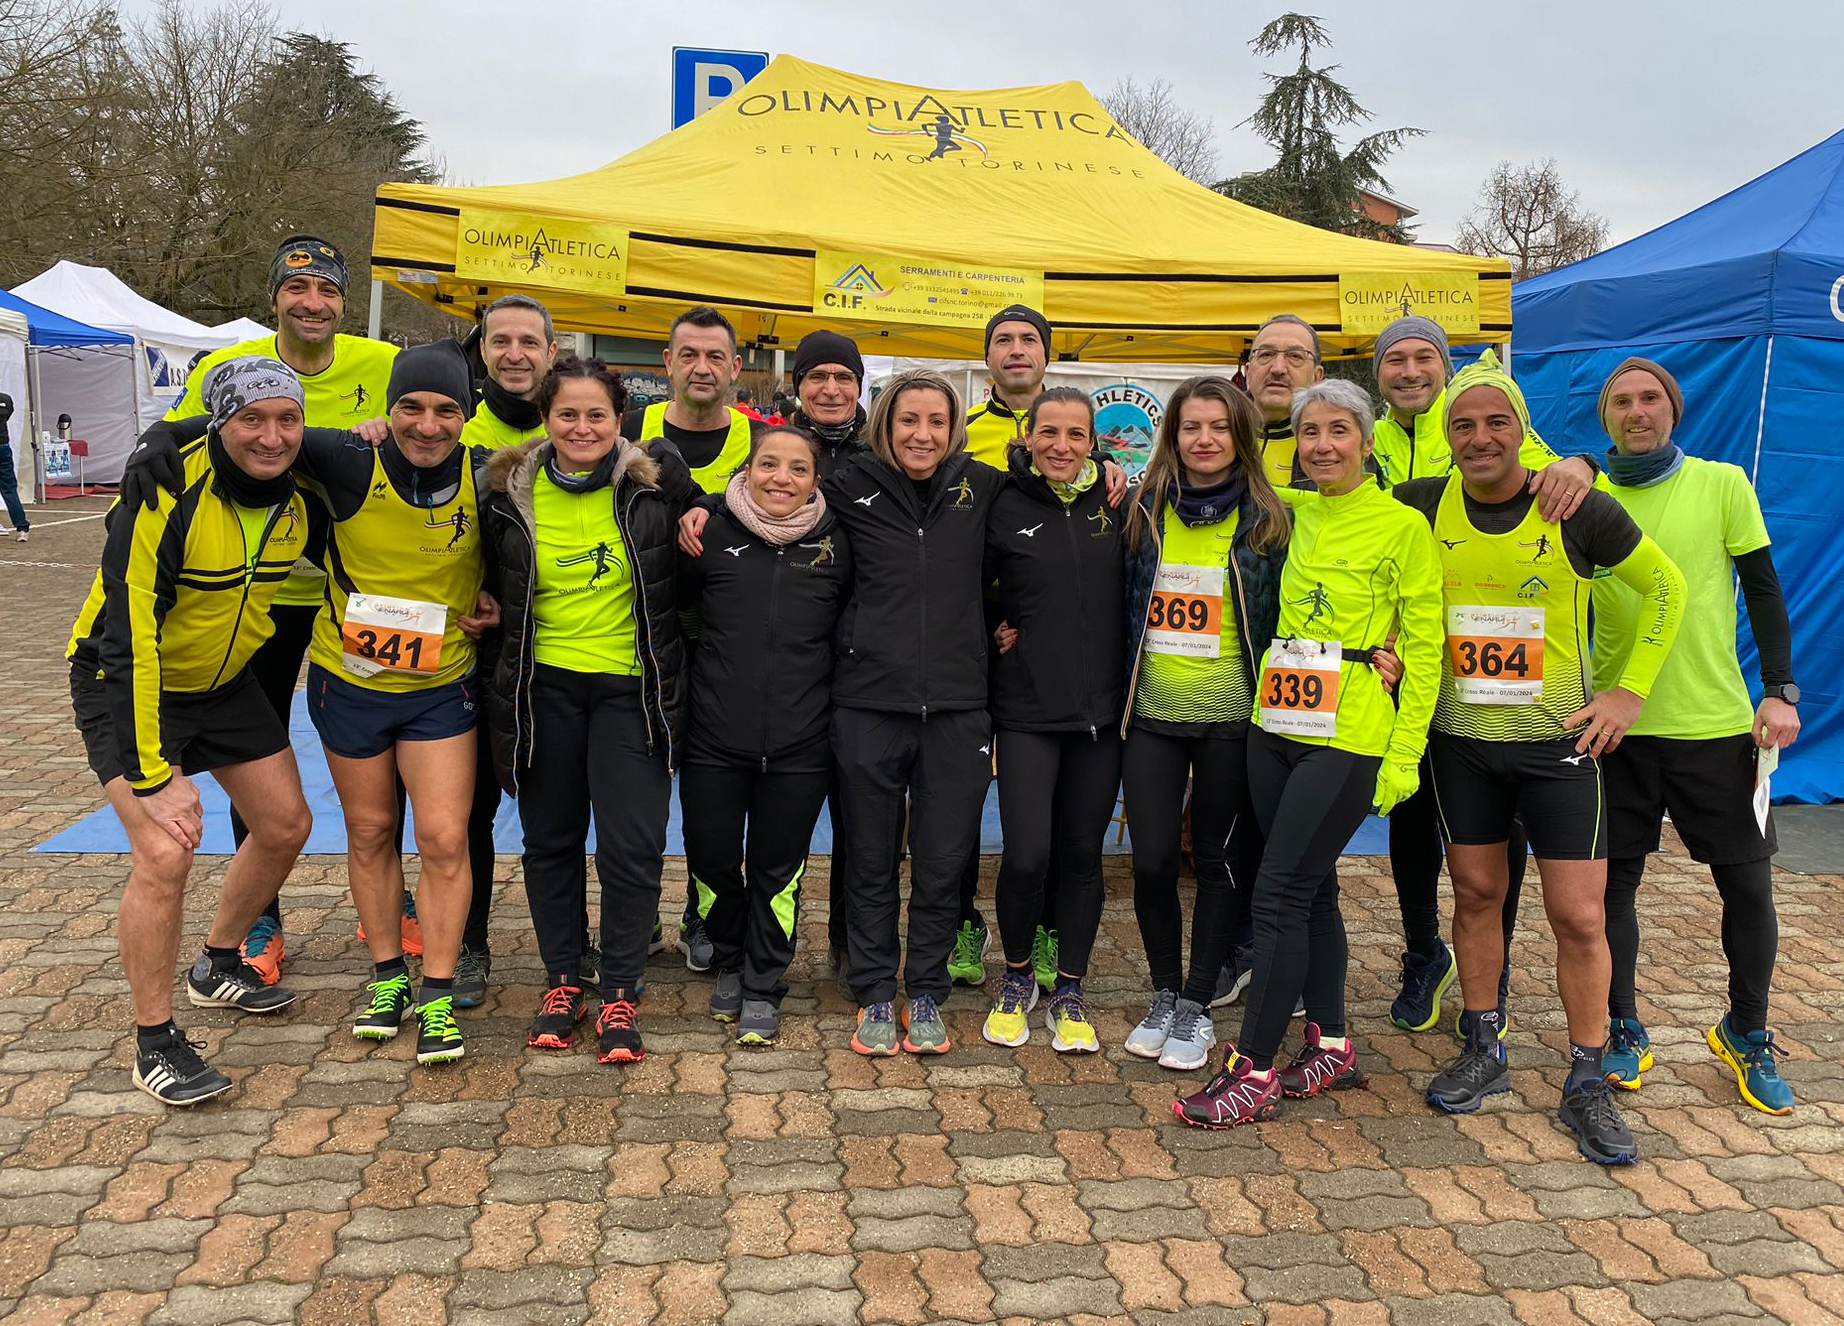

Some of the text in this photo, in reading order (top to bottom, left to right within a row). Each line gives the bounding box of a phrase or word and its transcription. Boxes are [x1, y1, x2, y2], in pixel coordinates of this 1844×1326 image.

[694, 62, 746, 119] P
[737, 90, 1134, 147] OLIMPIATLETICA
[755, 144, 1145, 179] SETTIMO TORINESE
[464, 227, 621, 260] OLIMPIATLETICA
[464, 256, 621, 281] SETTIMO TORINESE
[900, 265, 956, 278] SERRAMENTI
[965, 272, 1025, 285] CARPENTERIA
[823, 293, 867, 311] C.I.F.
[939, 298, 1011, 309] cifsnc.torino@gmail.co
[1345, 282, 1474, 305] OLIMPIATLETICA
[875, 305, 897, 313] Strada
[939, 311, 971, 320] campagna
[1425, 314, 1475, 322] ORINESE
[1148, 596, 1208, 631] 369
[356, 629, 423, 669] 341
[1458, 641, 1529, 678] 364
[1268, 672, 1323, 709] 339
[1296, 720, 1327, 728] 07/01/2024
